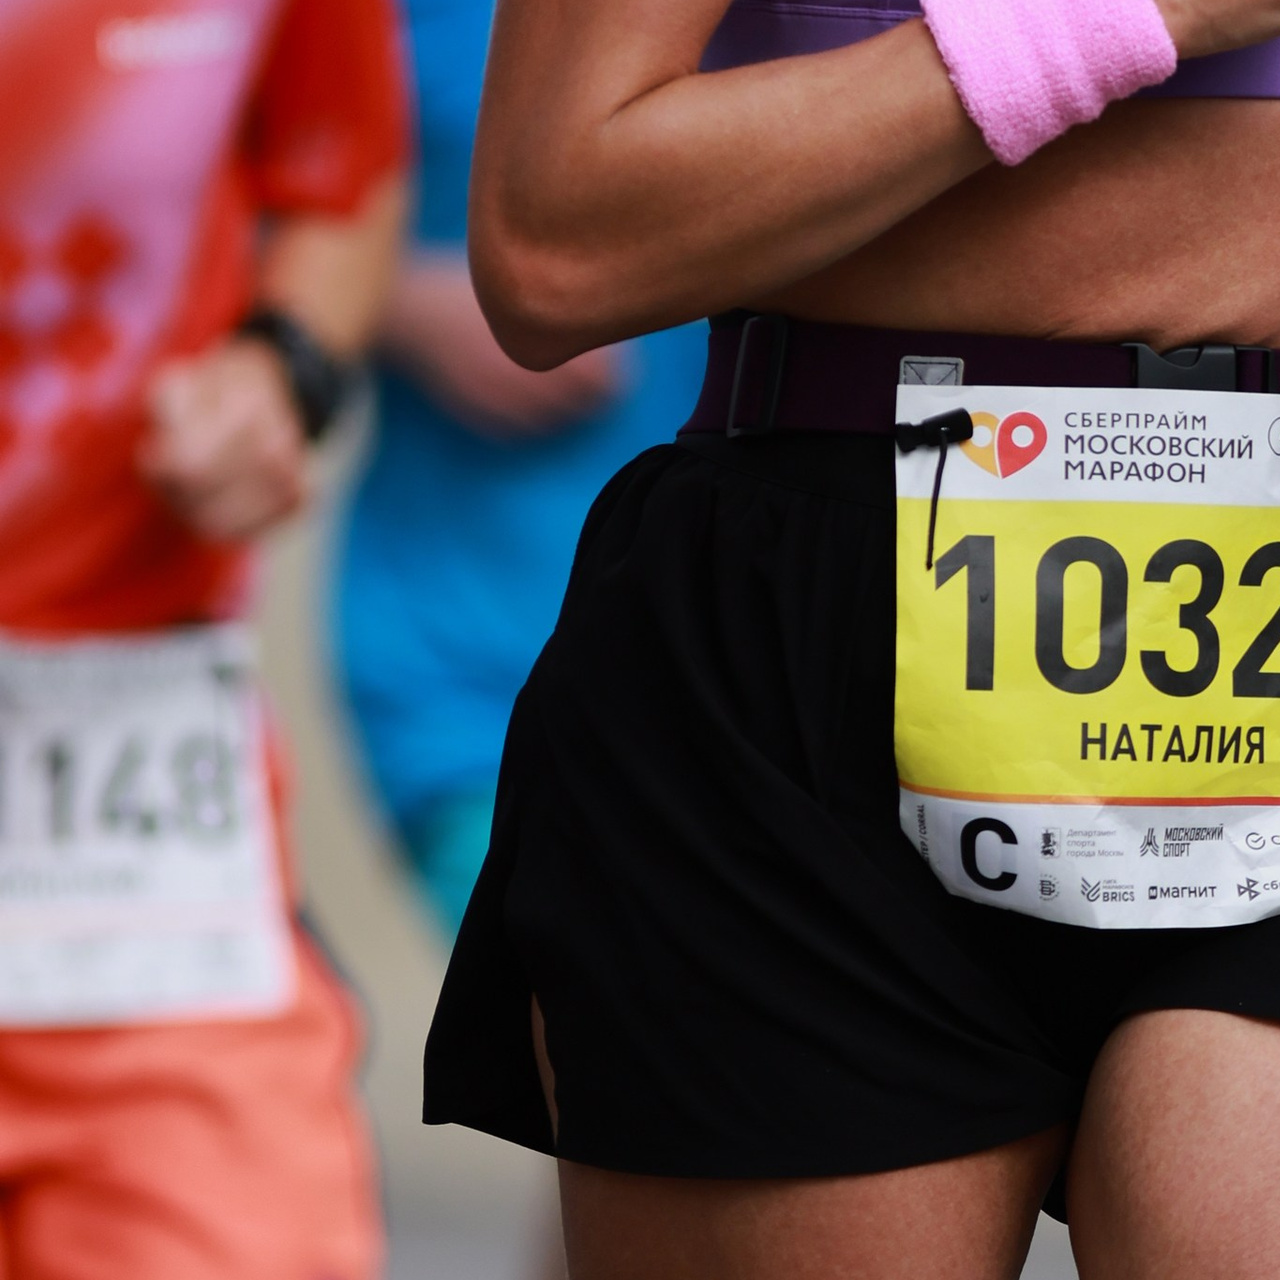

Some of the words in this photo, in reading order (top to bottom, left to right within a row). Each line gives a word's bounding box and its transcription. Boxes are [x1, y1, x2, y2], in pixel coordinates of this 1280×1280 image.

[1064, 411, 1207, 431] СБЕРПРАЙМ
[1064, 434, 1254, 460] МОСКОВСКИЙ
[1064, 460, 1206, 484] МАРАФОН
[1080, 722, 1266, 765] НАТАЛИЯ
[1163, 823, 1224, 842] МОСКОВСКИЙ
[1162, 842, 1191, 858] СПОРТ
[1102, 891, 1135, 902] BRICS
[1160, 886, 1217, 898] магнит
